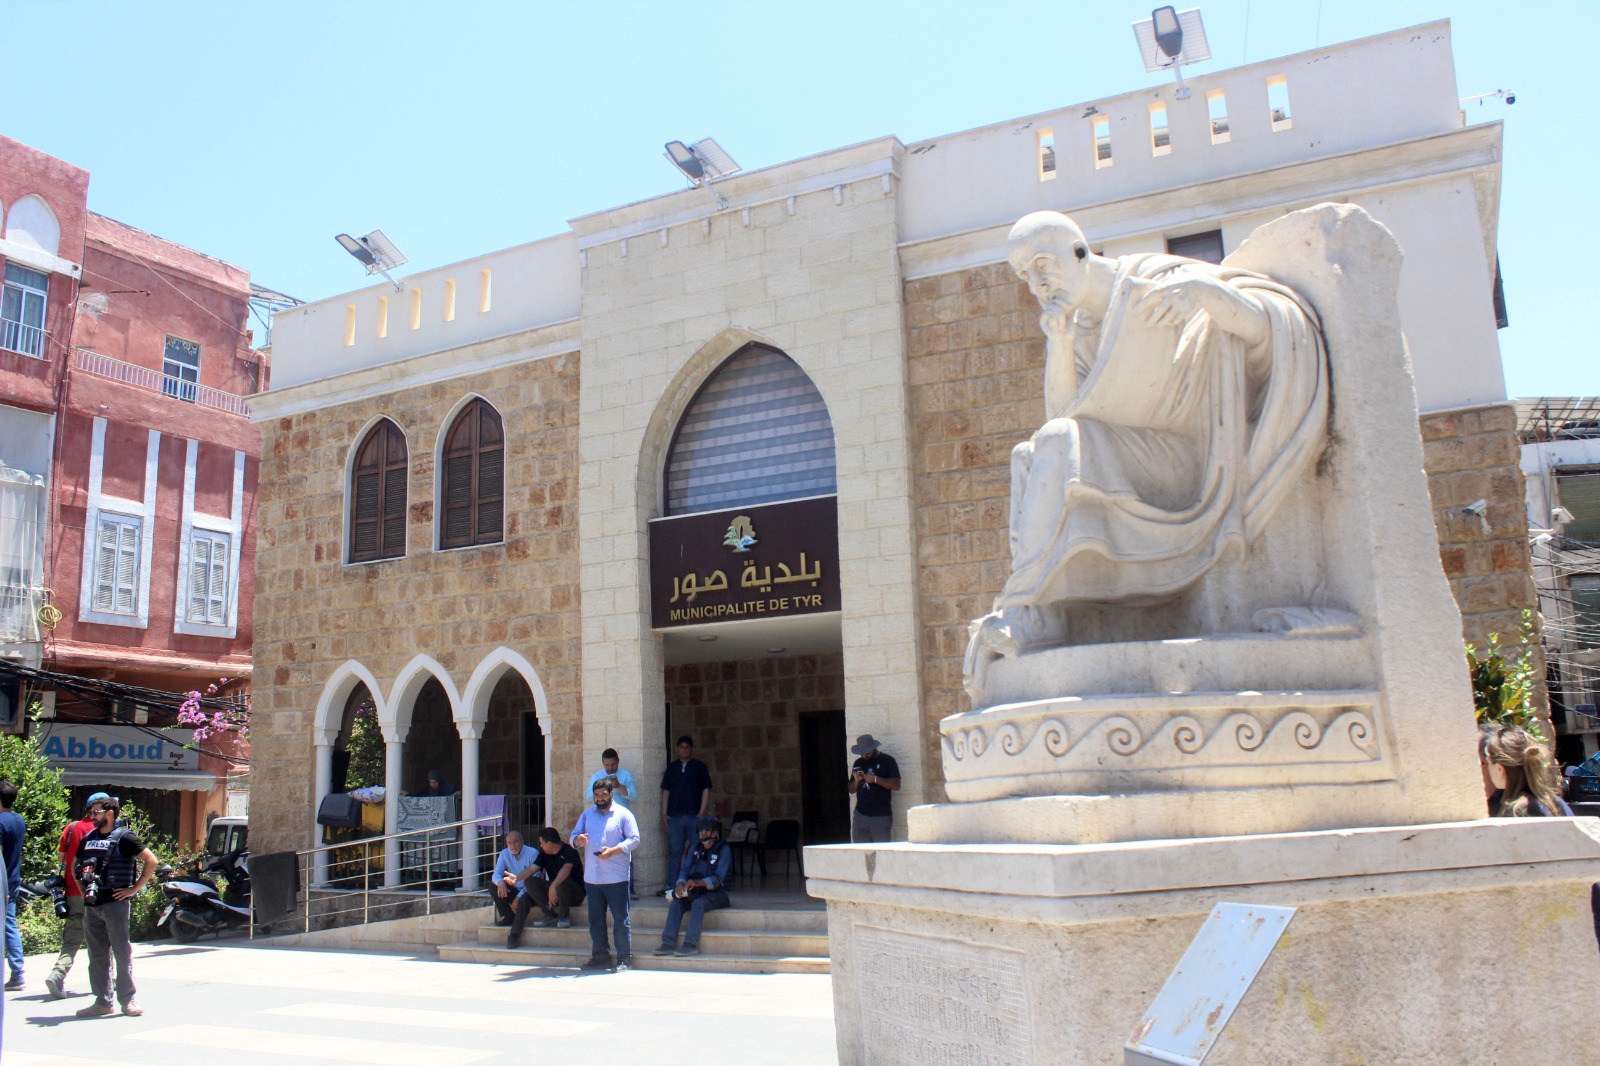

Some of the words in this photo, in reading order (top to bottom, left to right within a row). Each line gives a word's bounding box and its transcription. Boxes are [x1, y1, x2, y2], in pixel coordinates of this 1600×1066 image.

[740, 552, 822, 593] بلدية
[669, 569, 729, 604] صور
[670, 599, 766, 621] MUNICIPALITE
[769, 597, 790, 611] DE
[792, 594, 823, 609] TYR
[45, 736, 163, 760] Abboud
[87, 840, 110, 849] PRESS
